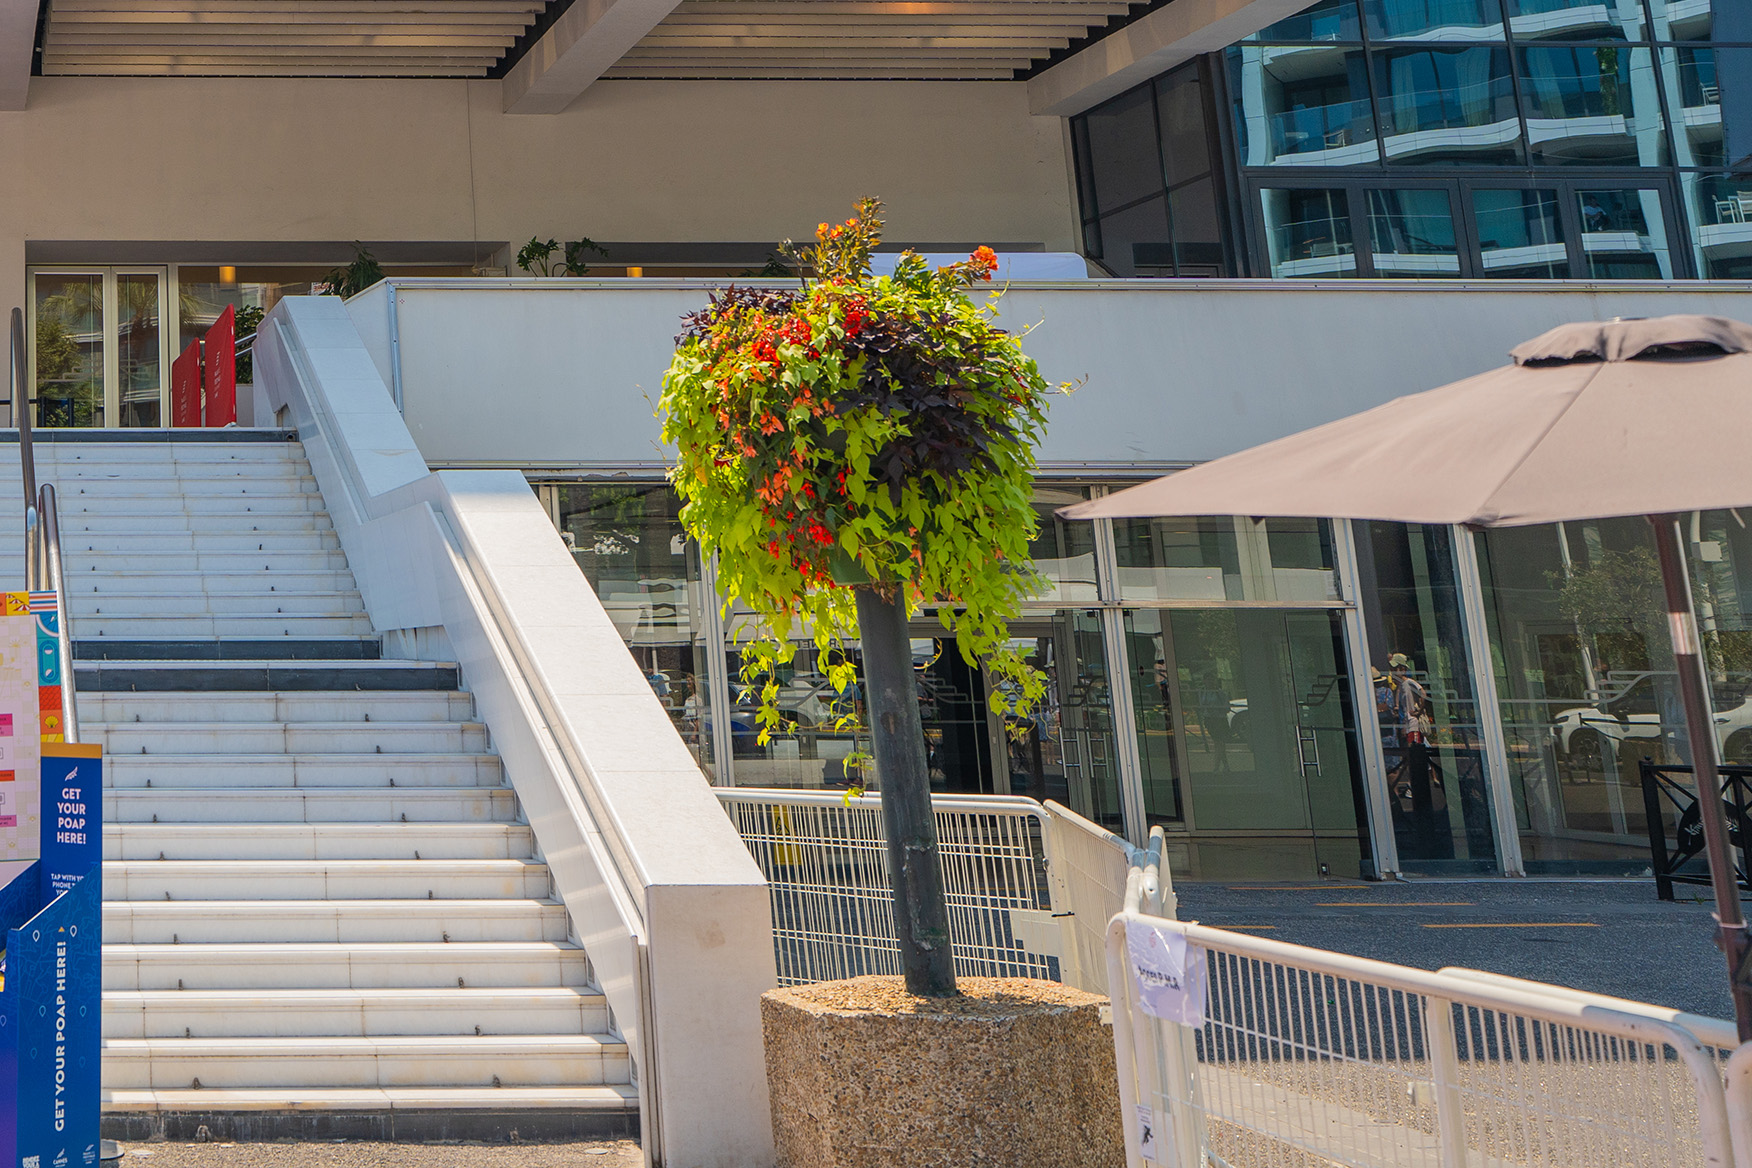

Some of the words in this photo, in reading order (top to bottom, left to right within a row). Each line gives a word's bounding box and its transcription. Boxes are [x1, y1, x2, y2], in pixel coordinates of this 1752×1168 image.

[62, 787, 81, 800] GET
[57, 802, 86, 815] YOUR
[57, 817, 86, 829] POAP
[57, 831, 87, 844] HERE!
[56, 941, 67, 993] HERE!
[55, 994, 66, 1043] POAP
[55, 1044, 66, 1097] YOUR
[54, 1099, 66, 1132] GET
